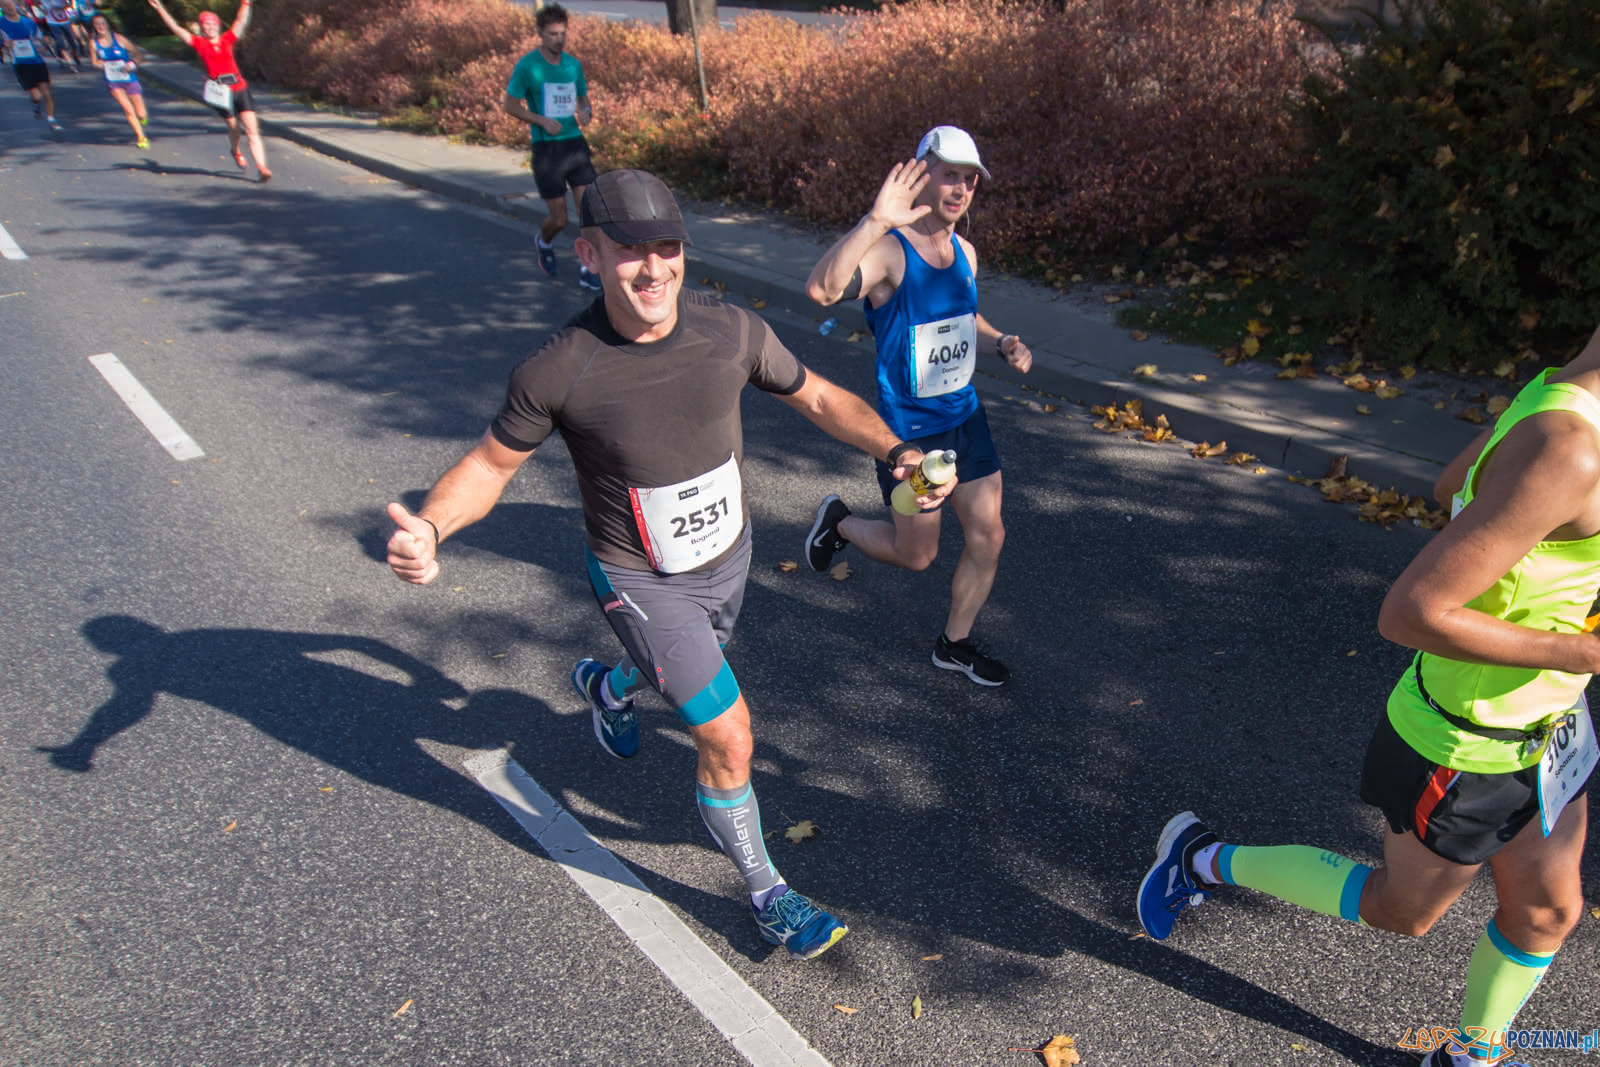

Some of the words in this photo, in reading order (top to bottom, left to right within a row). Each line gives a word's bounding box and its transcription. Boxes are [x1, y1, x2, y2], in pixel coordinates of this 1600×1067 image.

[928, 340, 969, 365] 4049
[670, 496, 729, 539] 2531
[1555, 747, 1579, 778] Sebastian
[726, 806, 760, 869] kalenji
